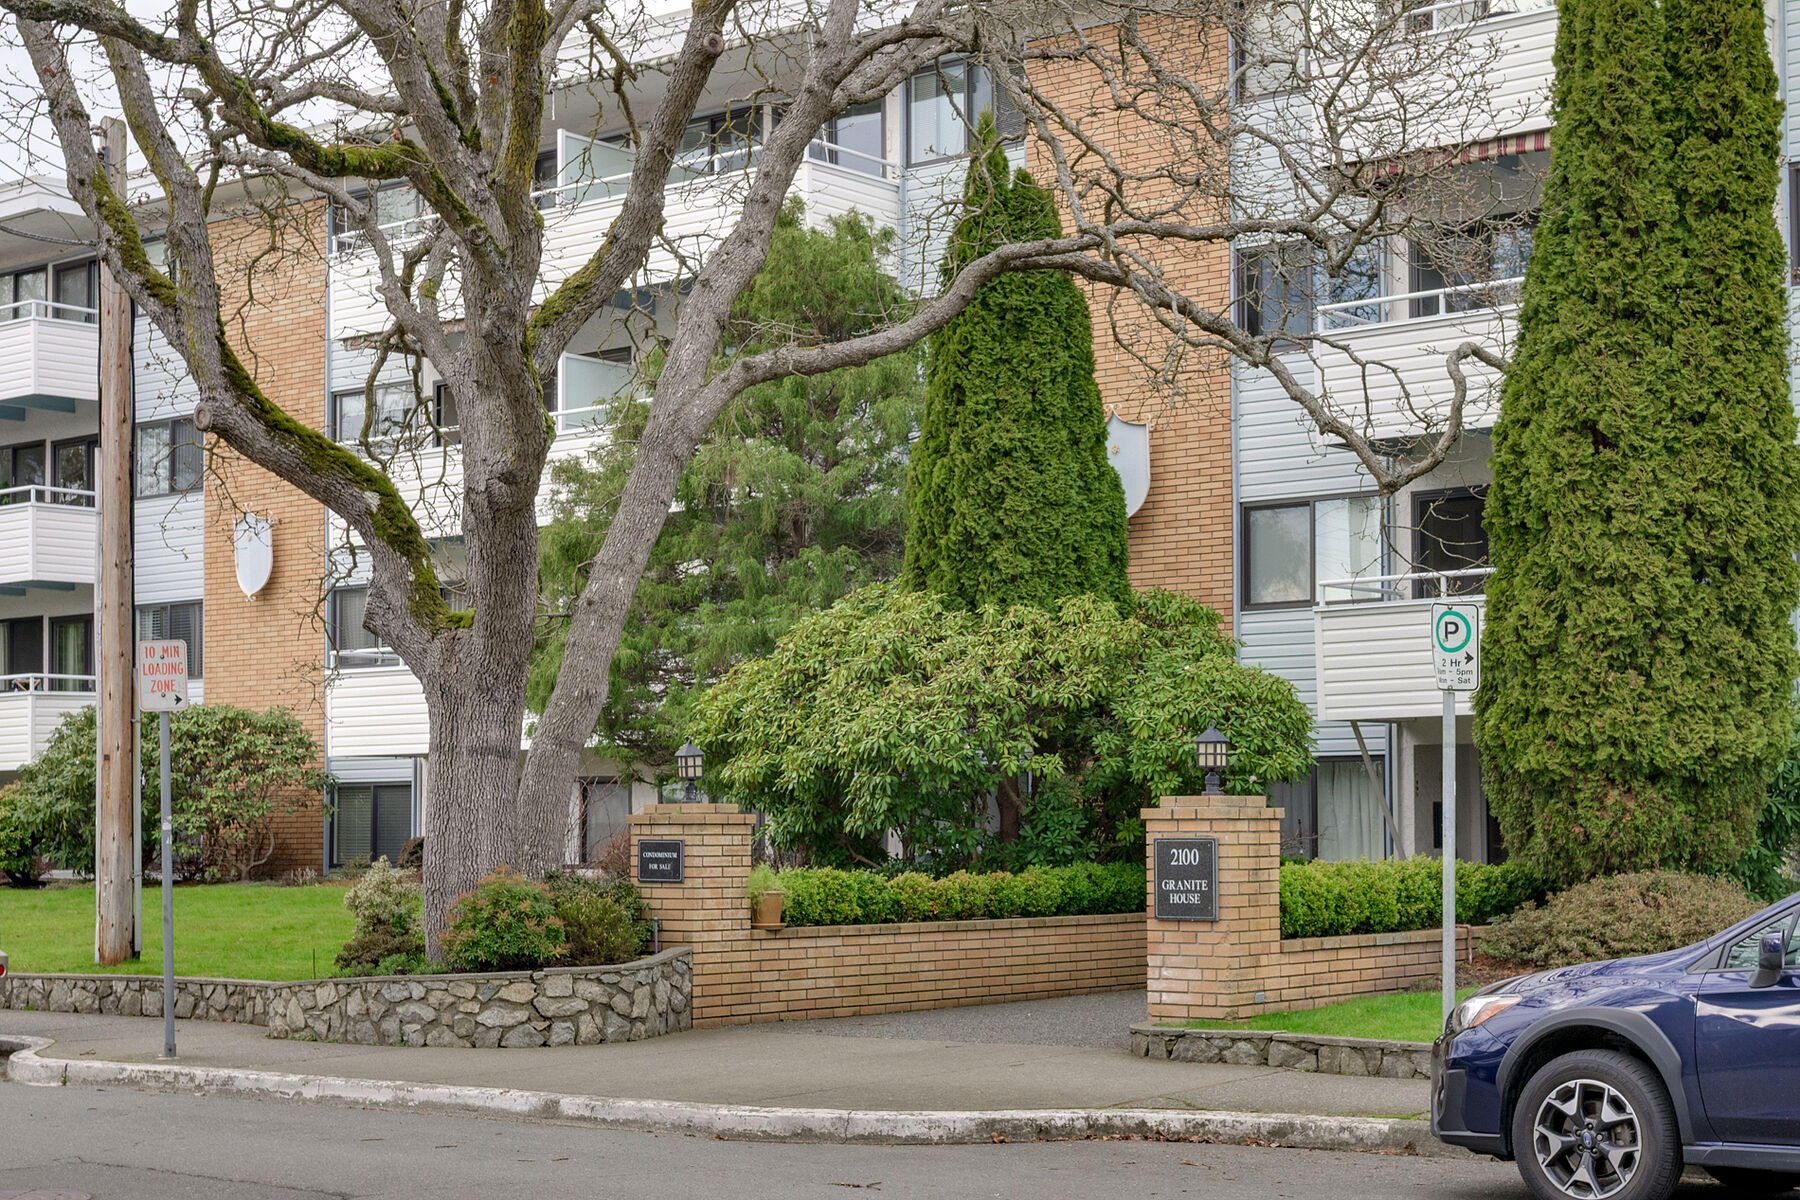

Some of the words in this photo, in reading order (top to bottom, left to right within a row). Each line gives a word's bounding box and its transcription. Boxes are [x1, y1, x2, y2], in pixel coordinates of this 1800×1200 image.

[1444, 621, 1459, 641] P
[144, 646, 155, 659] 10
[162, 645, 179, 658] MIN
[142, 662, 183, 676] LOADING
[1442, 658, 1446, 667] 2
[1450, 659, 1461, 667] Hr
[1456, 668, 1473, 676] 5pm
[151, 680, 176, 693] ZONE
[1170, 848, 1199, 866] 2100
[1161, 879, 1208, 891] GRANITE
[1169, 893, 1201, 904] HOUSE
